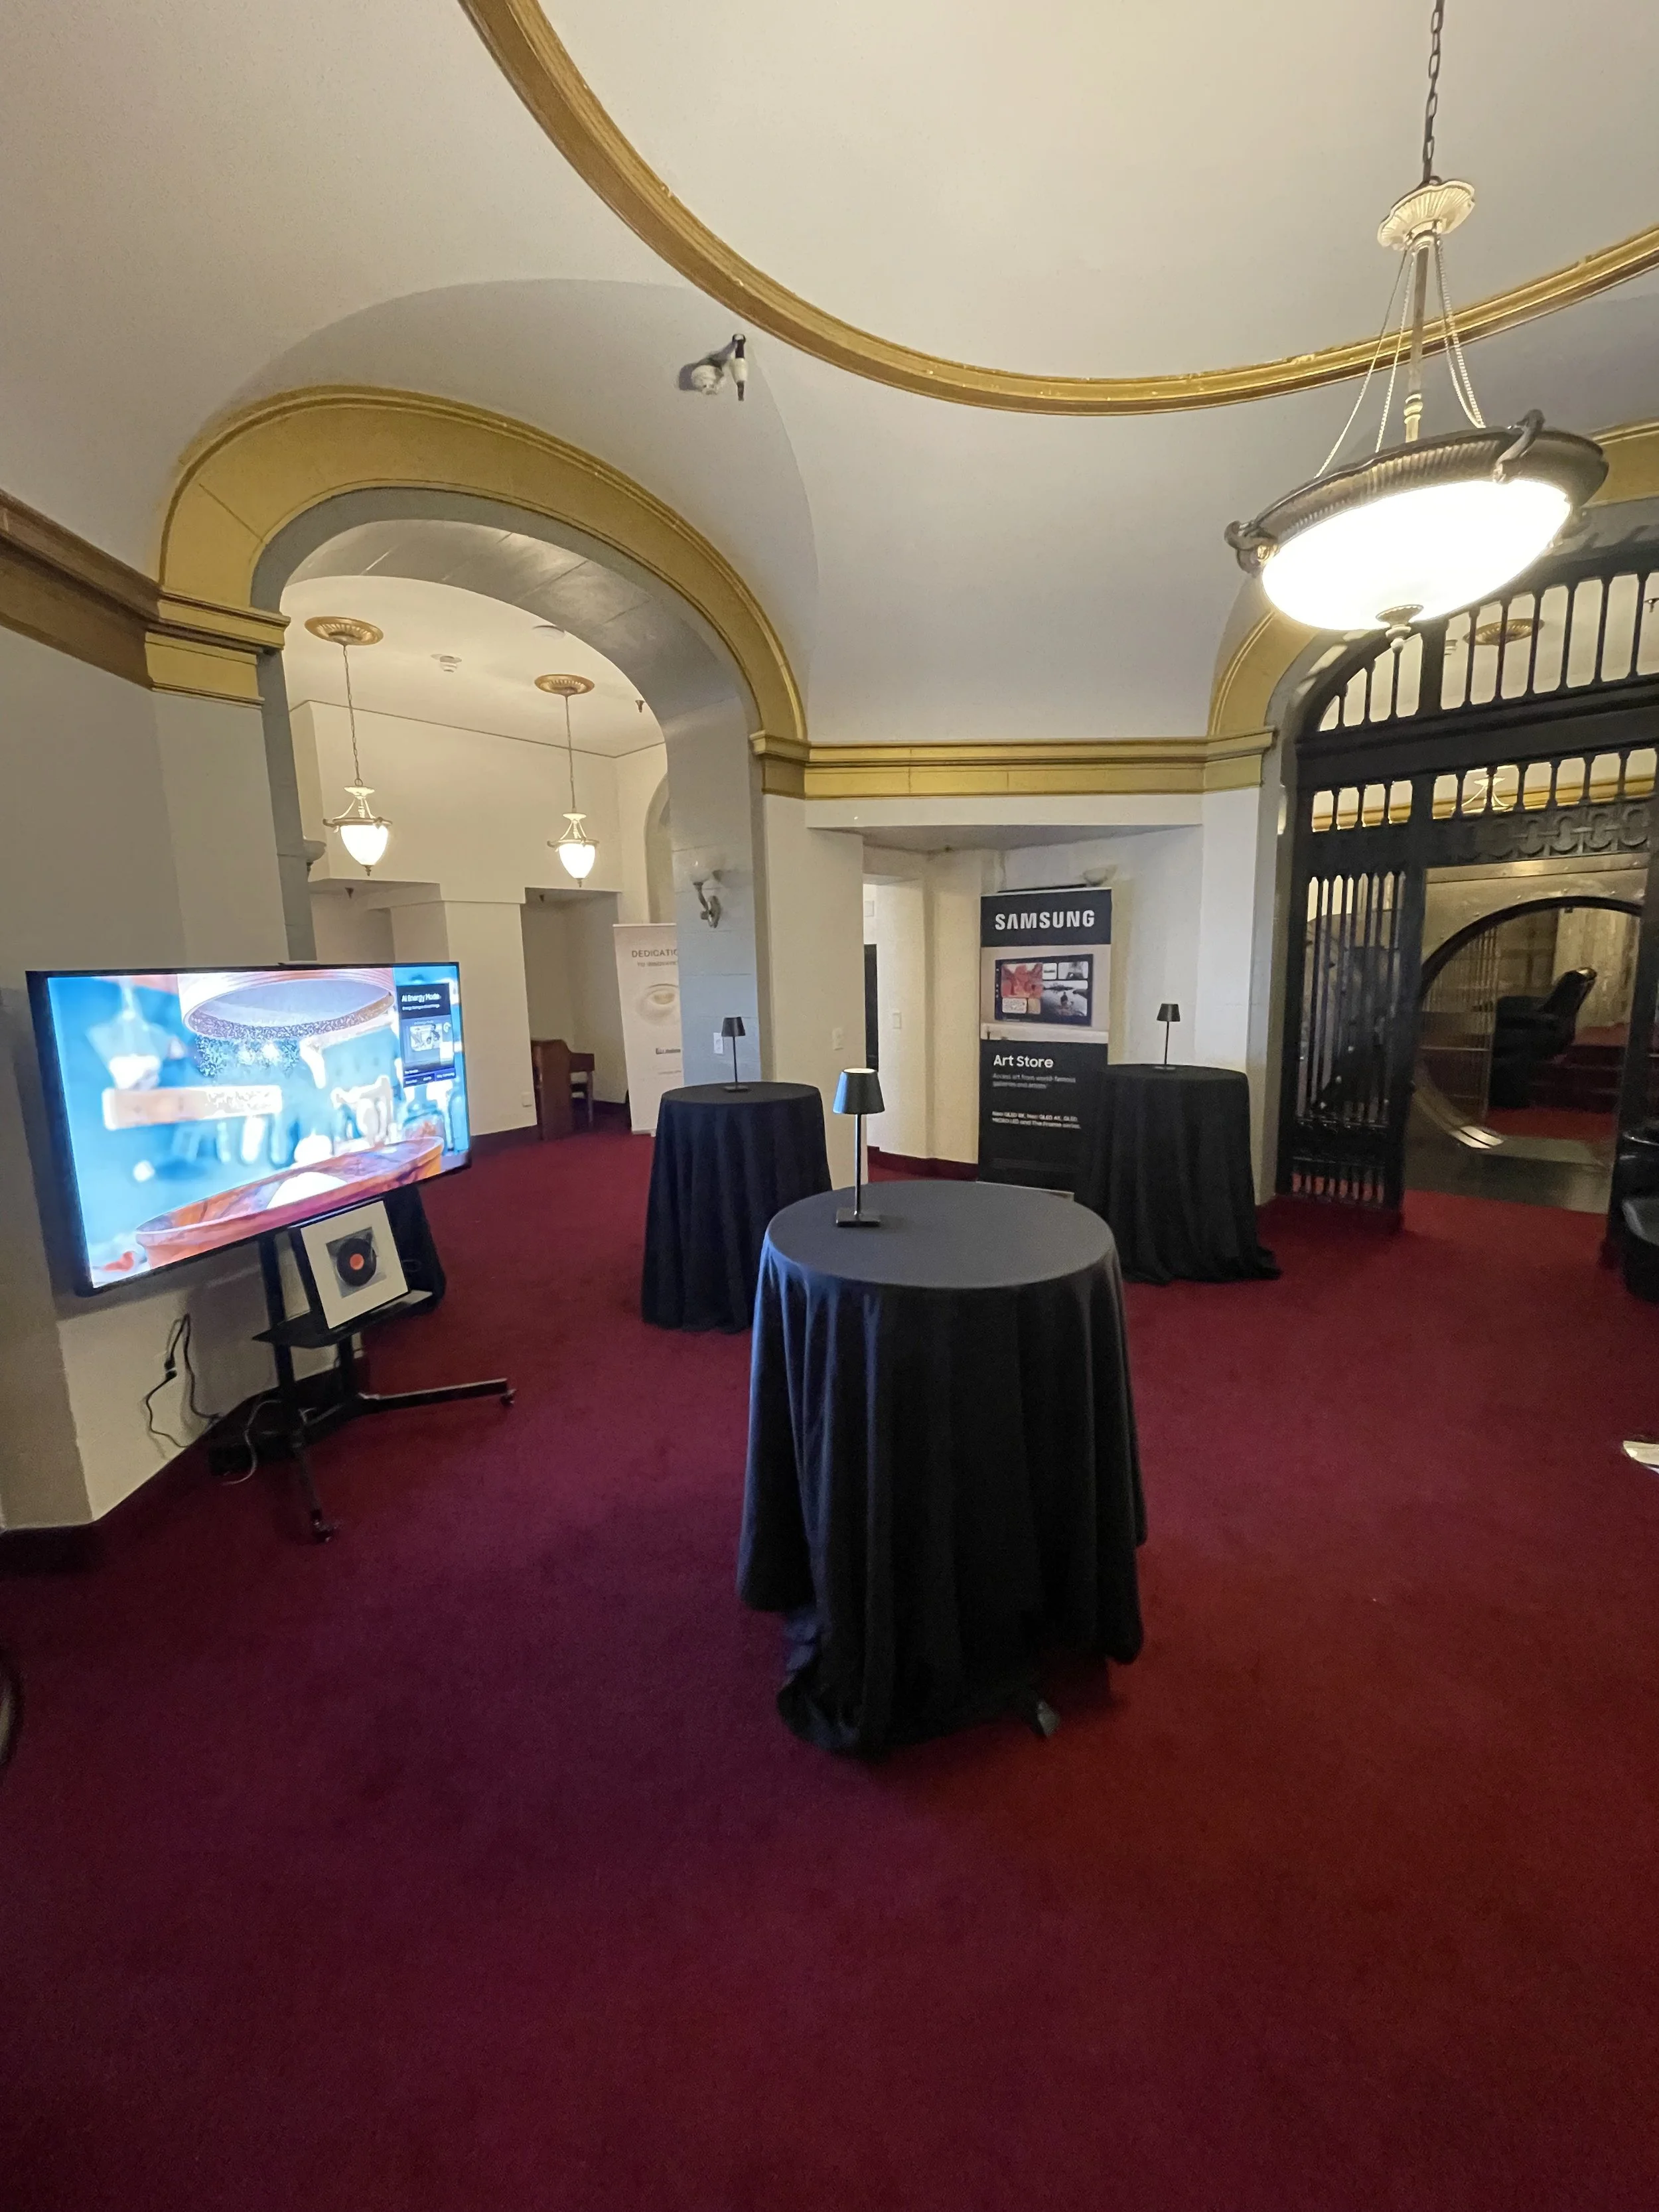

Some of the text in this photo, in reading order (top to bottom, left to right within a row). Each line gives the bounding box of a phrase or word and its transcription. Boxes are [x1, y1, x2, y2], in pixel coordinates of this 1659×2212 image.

[995, 910, 1095, 930] SAMSUNG
[407, 994, 425, 1003] Energy
[993, 1055, 1054, 1068] Art Store
